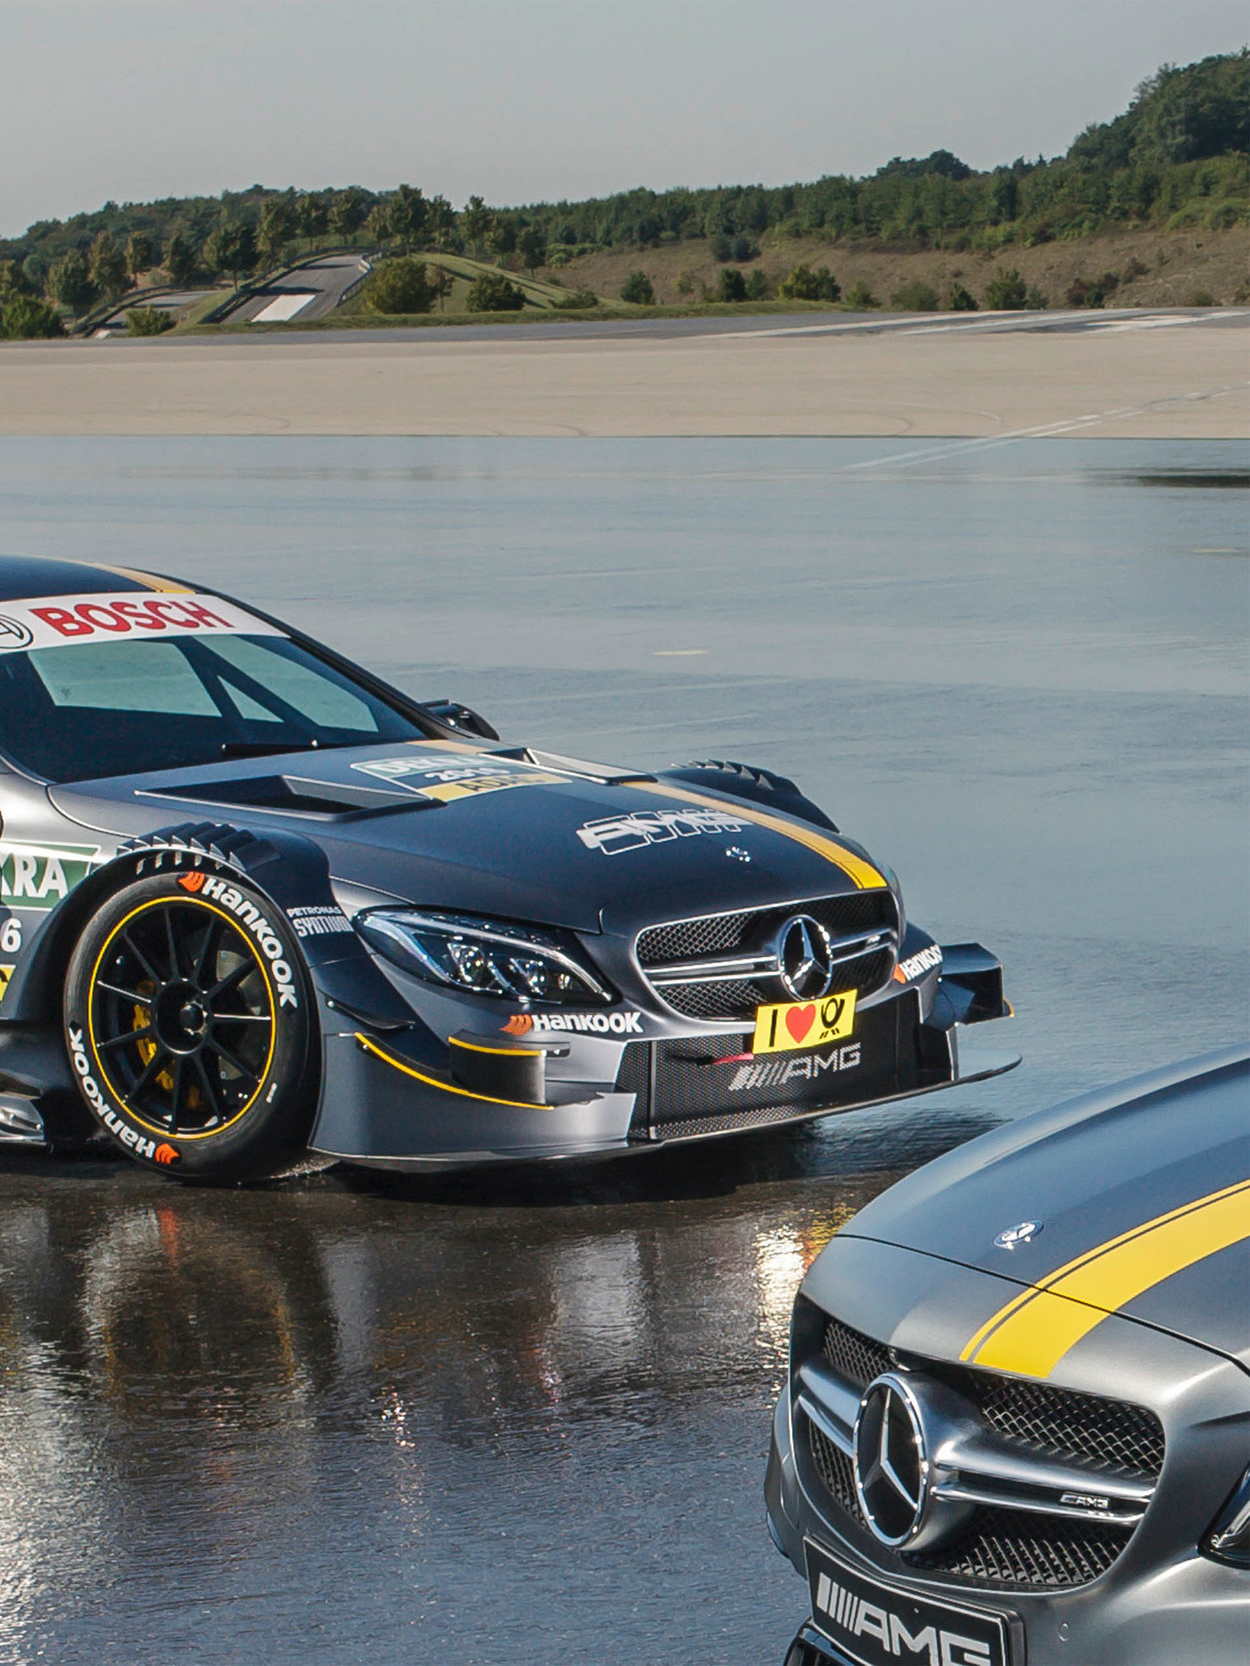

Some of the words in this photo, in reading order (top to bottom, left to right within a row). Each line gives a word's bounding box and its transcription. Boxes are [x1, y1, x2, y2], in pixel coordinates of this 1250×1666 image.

[29, 600, 236, 637] BOSCH
[576, 813, 754, 850] AMG
[768, 1008, 778, 1048] I
[778, 1042, 862, 1085] AMG
[853, 1599, 991, 1666] AMG
